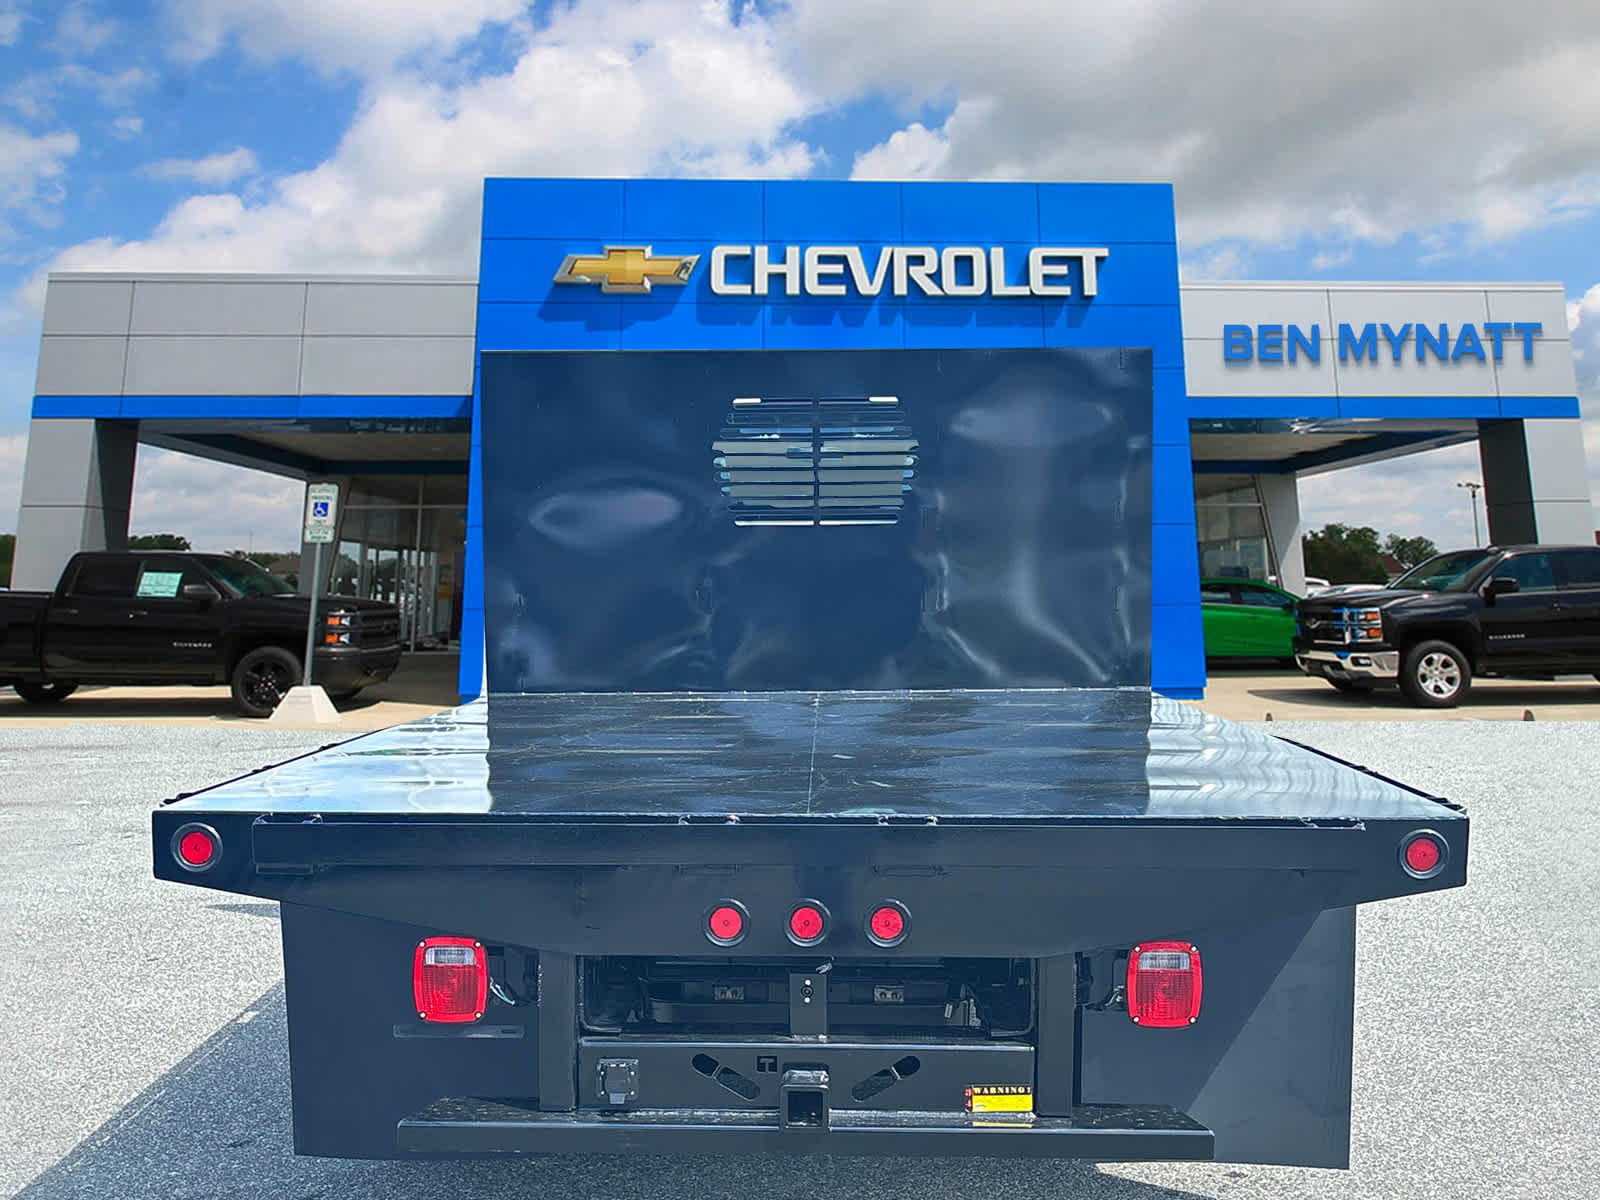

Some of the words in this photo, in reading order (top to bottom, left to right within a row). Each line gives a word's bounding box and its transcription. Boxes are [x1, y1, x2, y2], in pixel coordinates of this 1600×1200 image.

[711, 245, 1109, 297] CHEVROLET
[1223, 323, 1321, 363] BEN
[1338, 322, 1542, 363] MYNATT
